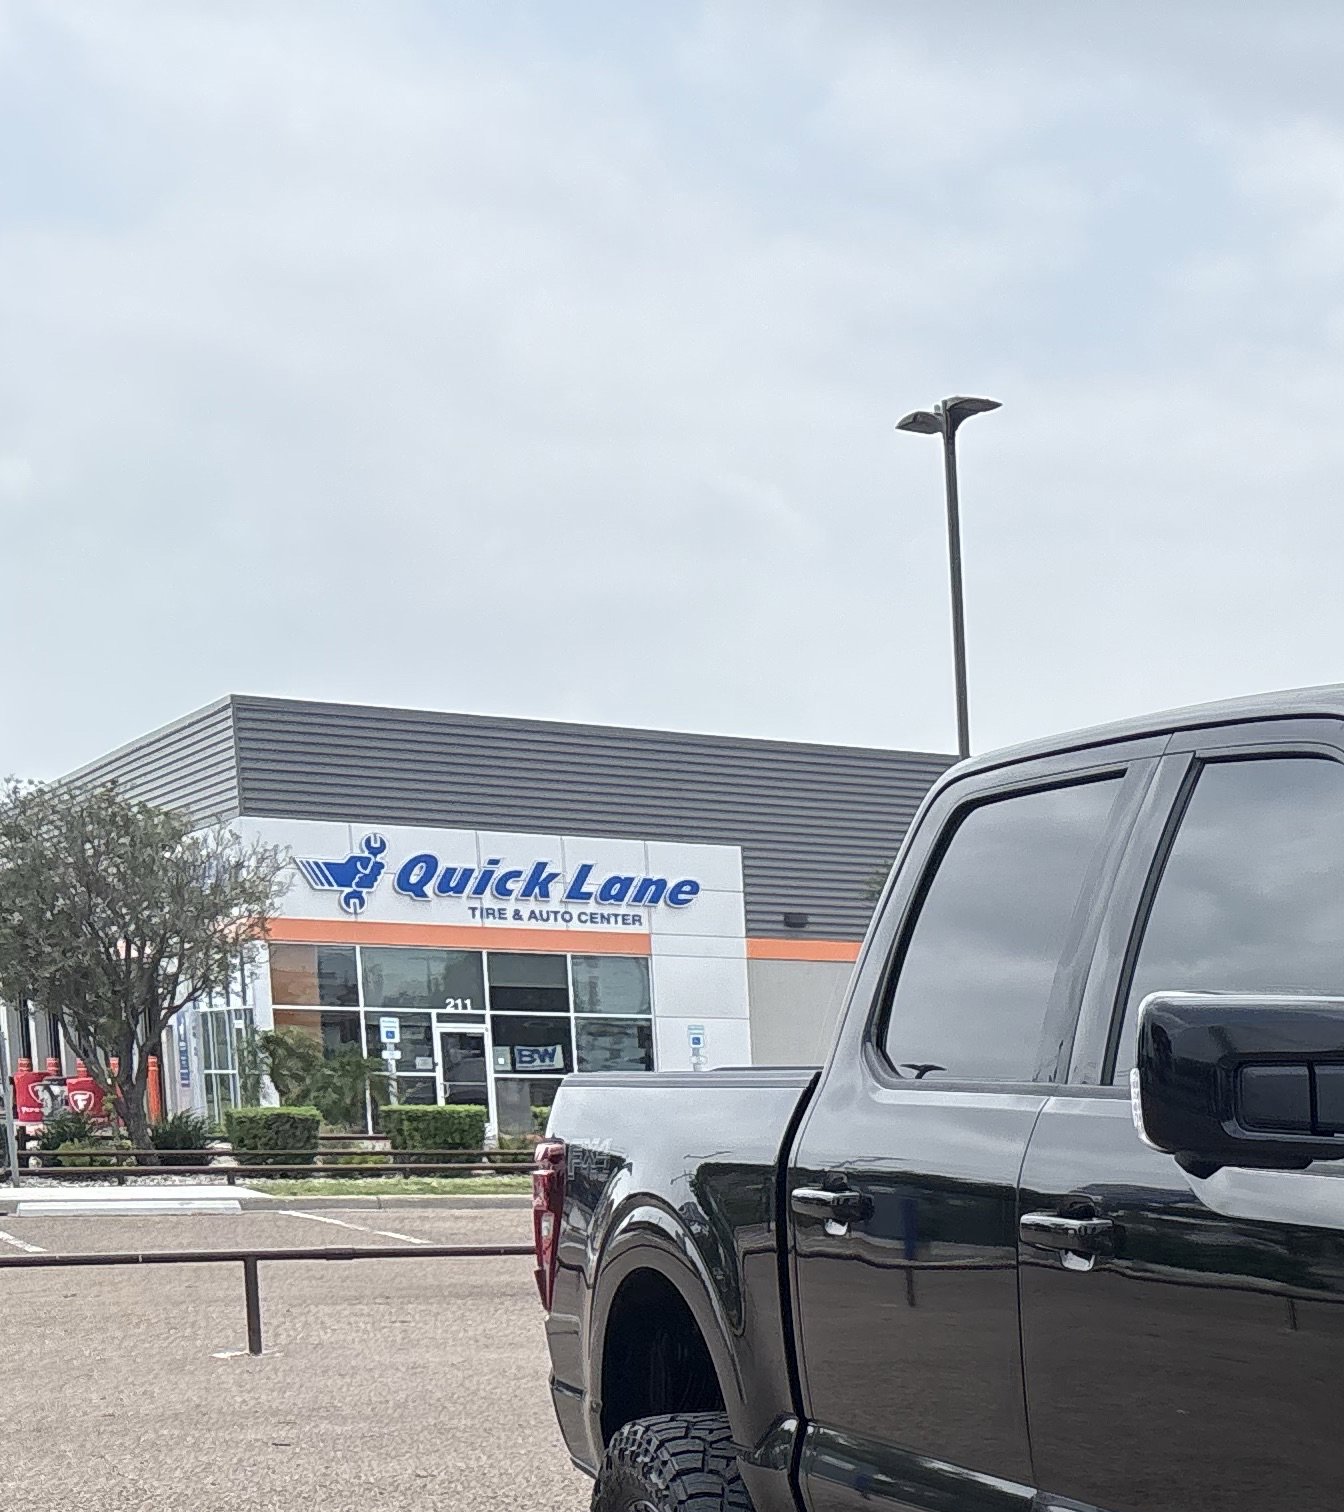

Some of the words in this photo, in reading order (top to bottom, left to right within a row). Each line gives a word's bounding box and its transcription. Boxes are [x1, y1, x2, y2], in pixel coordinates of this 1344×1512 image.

[397, 853, 561, 901] Quick
[564, 863, 701, 906] Lane
[468, 906, 507, 920] TIRE
[513, 909, 524, 921] &
[527, 910, 573, 923] AUTO
[577, 912, 642, 926] CENTER
[445, 998, 472, 1010] 211
